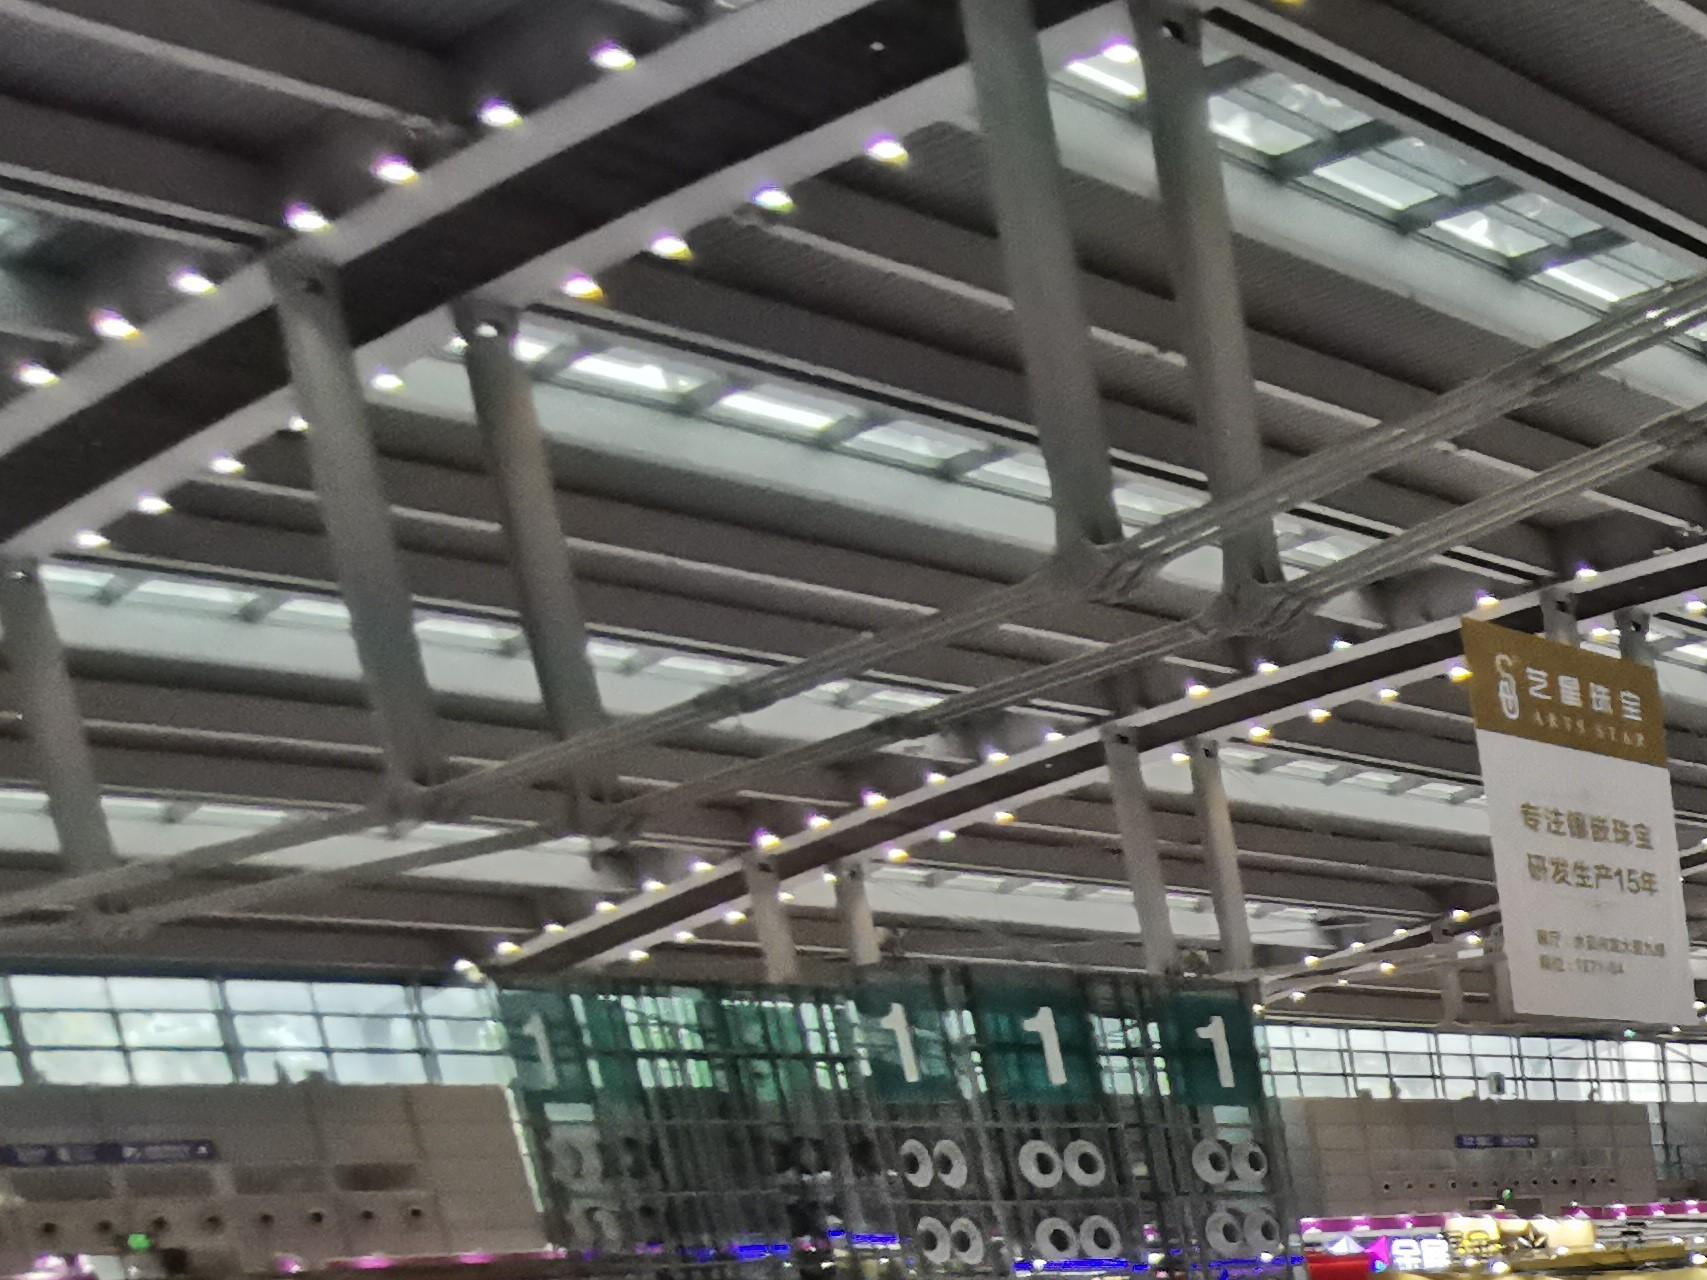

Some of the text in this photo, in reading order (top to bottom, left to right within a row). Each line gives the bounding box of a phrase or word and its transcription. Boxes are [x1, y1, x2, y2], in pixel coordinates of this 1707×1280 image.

[1527, 853, 1658, 896] 研发生产15年
[880, 1003, 919, 1083] 1
[1023, 1006, 1067, 1086] 1
[1196, 1015, 1234, 1089] 1
